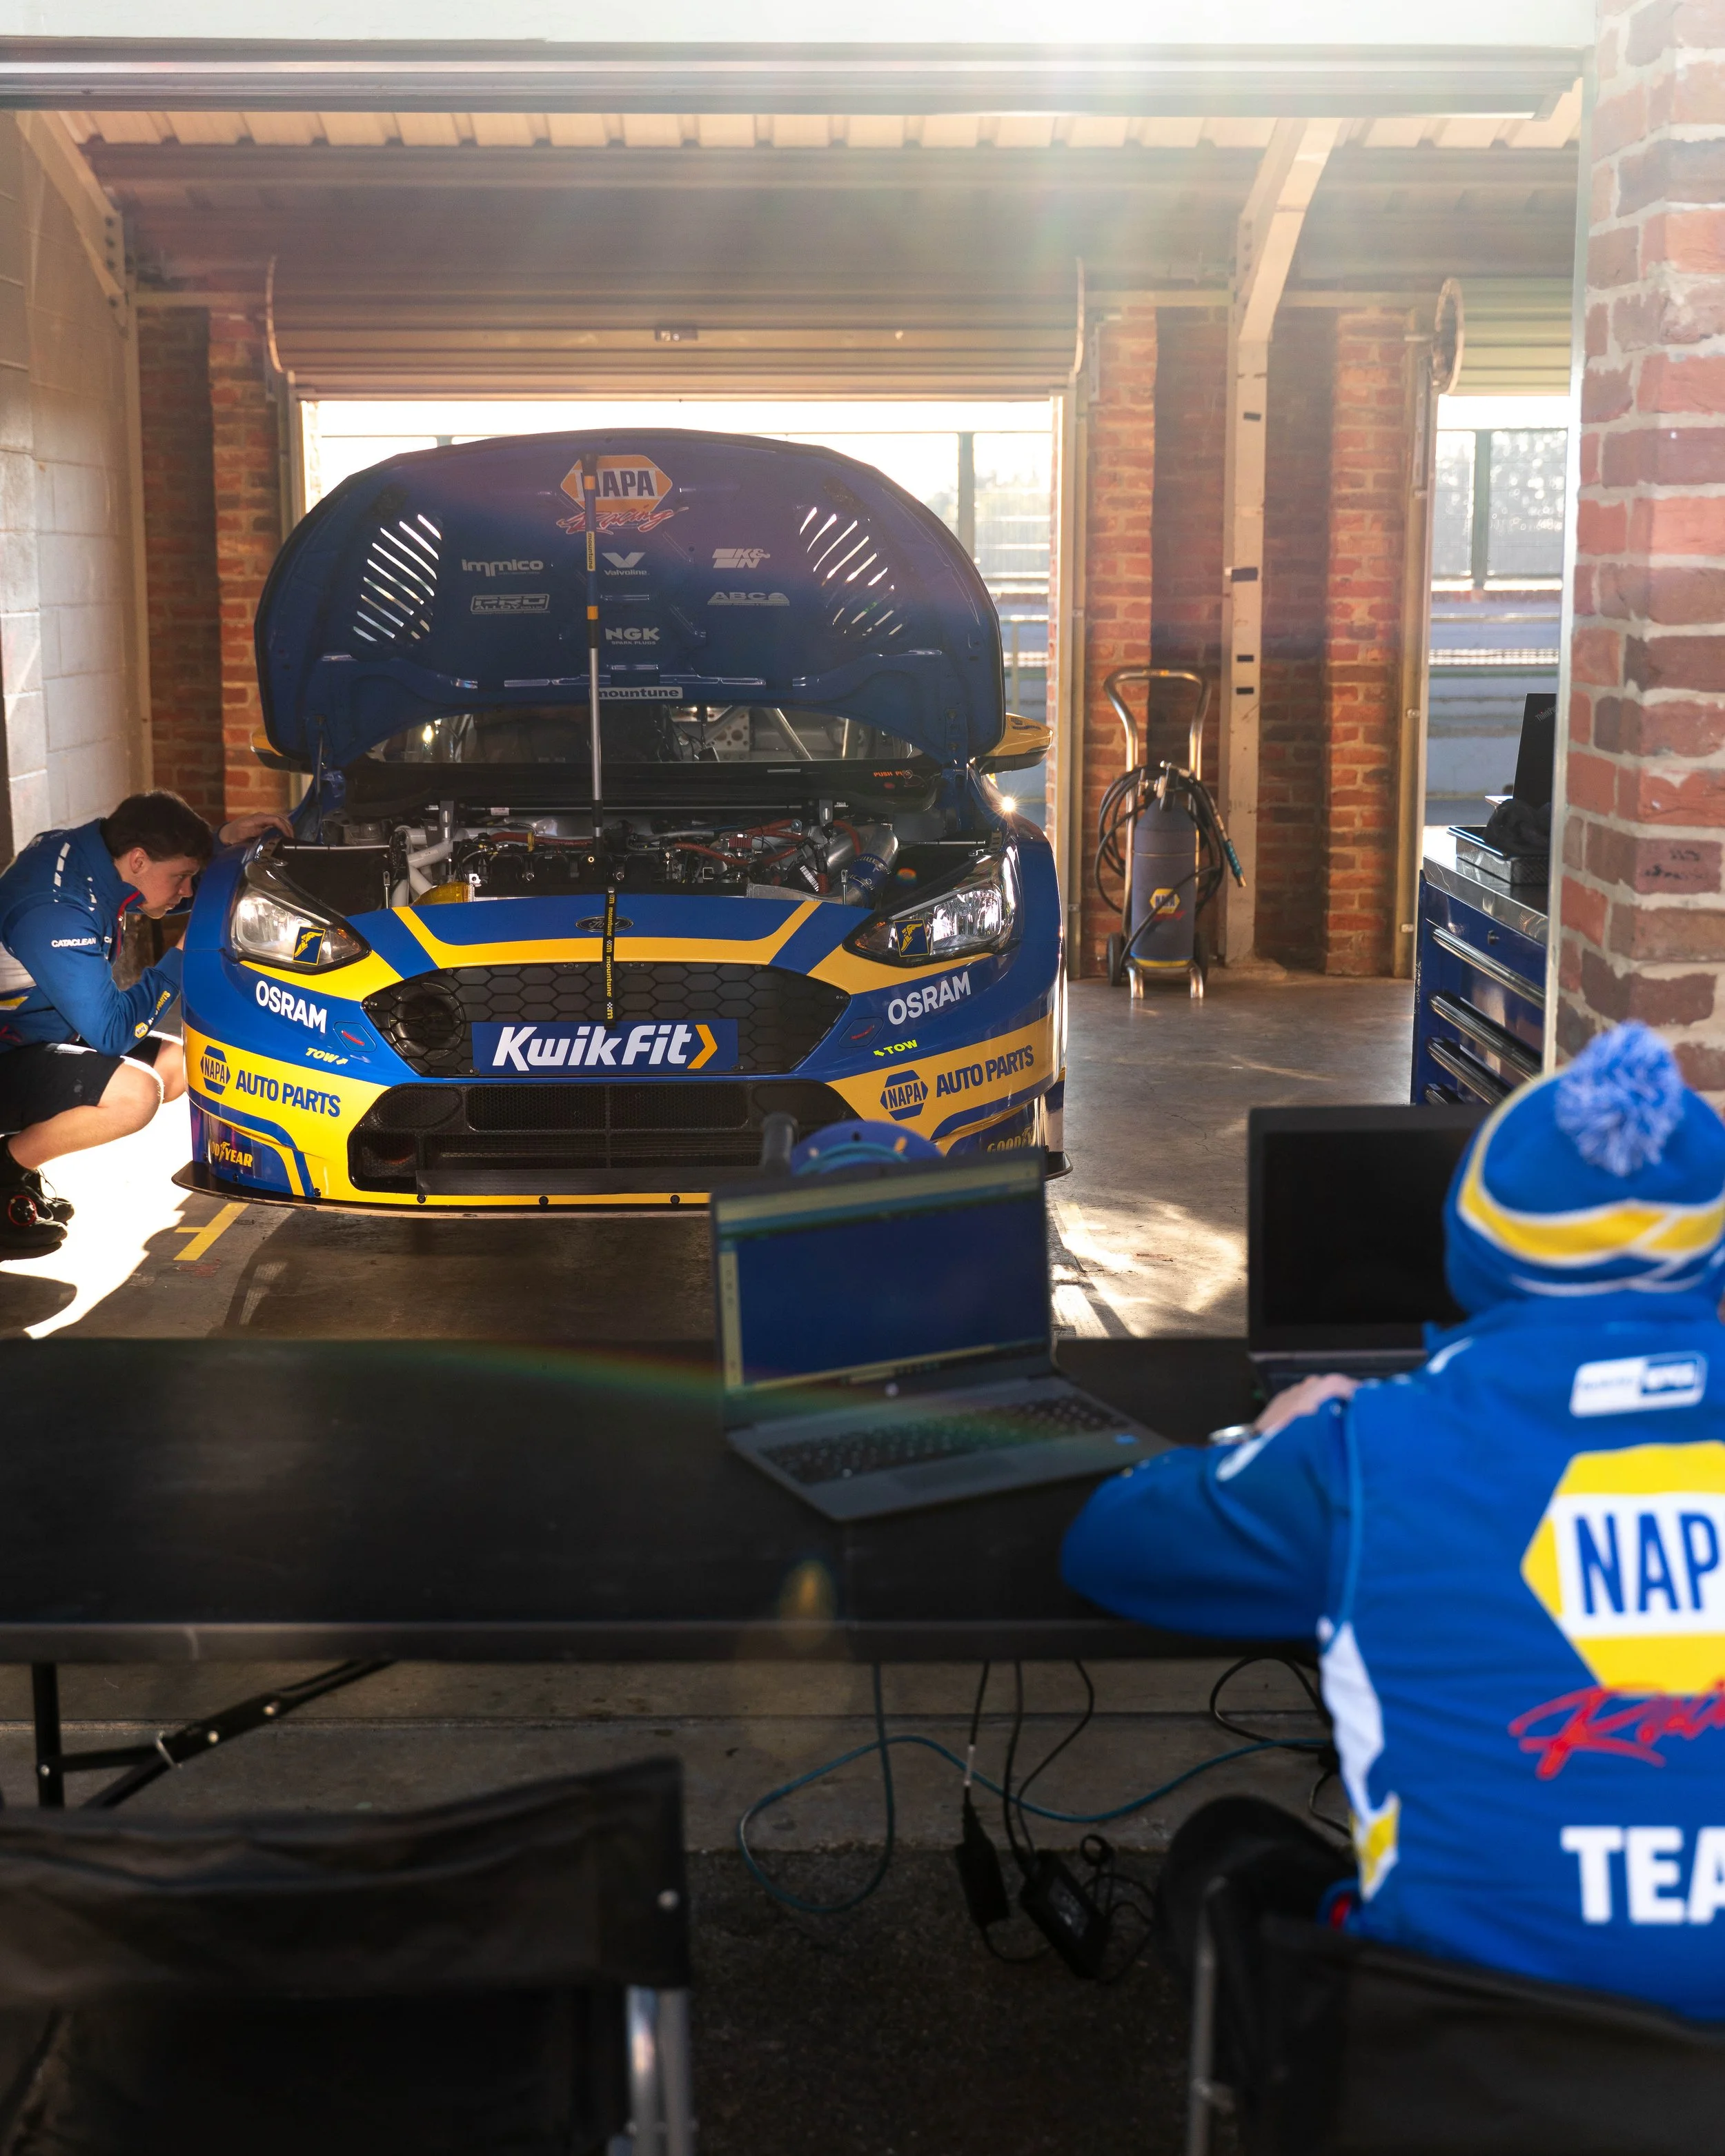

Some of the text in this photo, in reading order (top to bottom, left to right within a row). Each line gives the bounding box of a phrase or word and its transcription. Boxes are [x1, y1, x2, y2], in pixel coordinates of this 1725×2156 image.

[605, 627, 660, 640] NGK
[51, 937, 97, 948] CATACLEAN
[255, 980, 327, 1034] OSRAM
[887, 971, 972, 1025] OSRAM
[305, 1047, 339, 1063] TOW
[883, 1039, 918, 1055] TOW
[204, 1056, 341, 1118] NAPA AUTO PARTS
[888, 1045, 1034, 1109] NAPA AUTO PARTS
